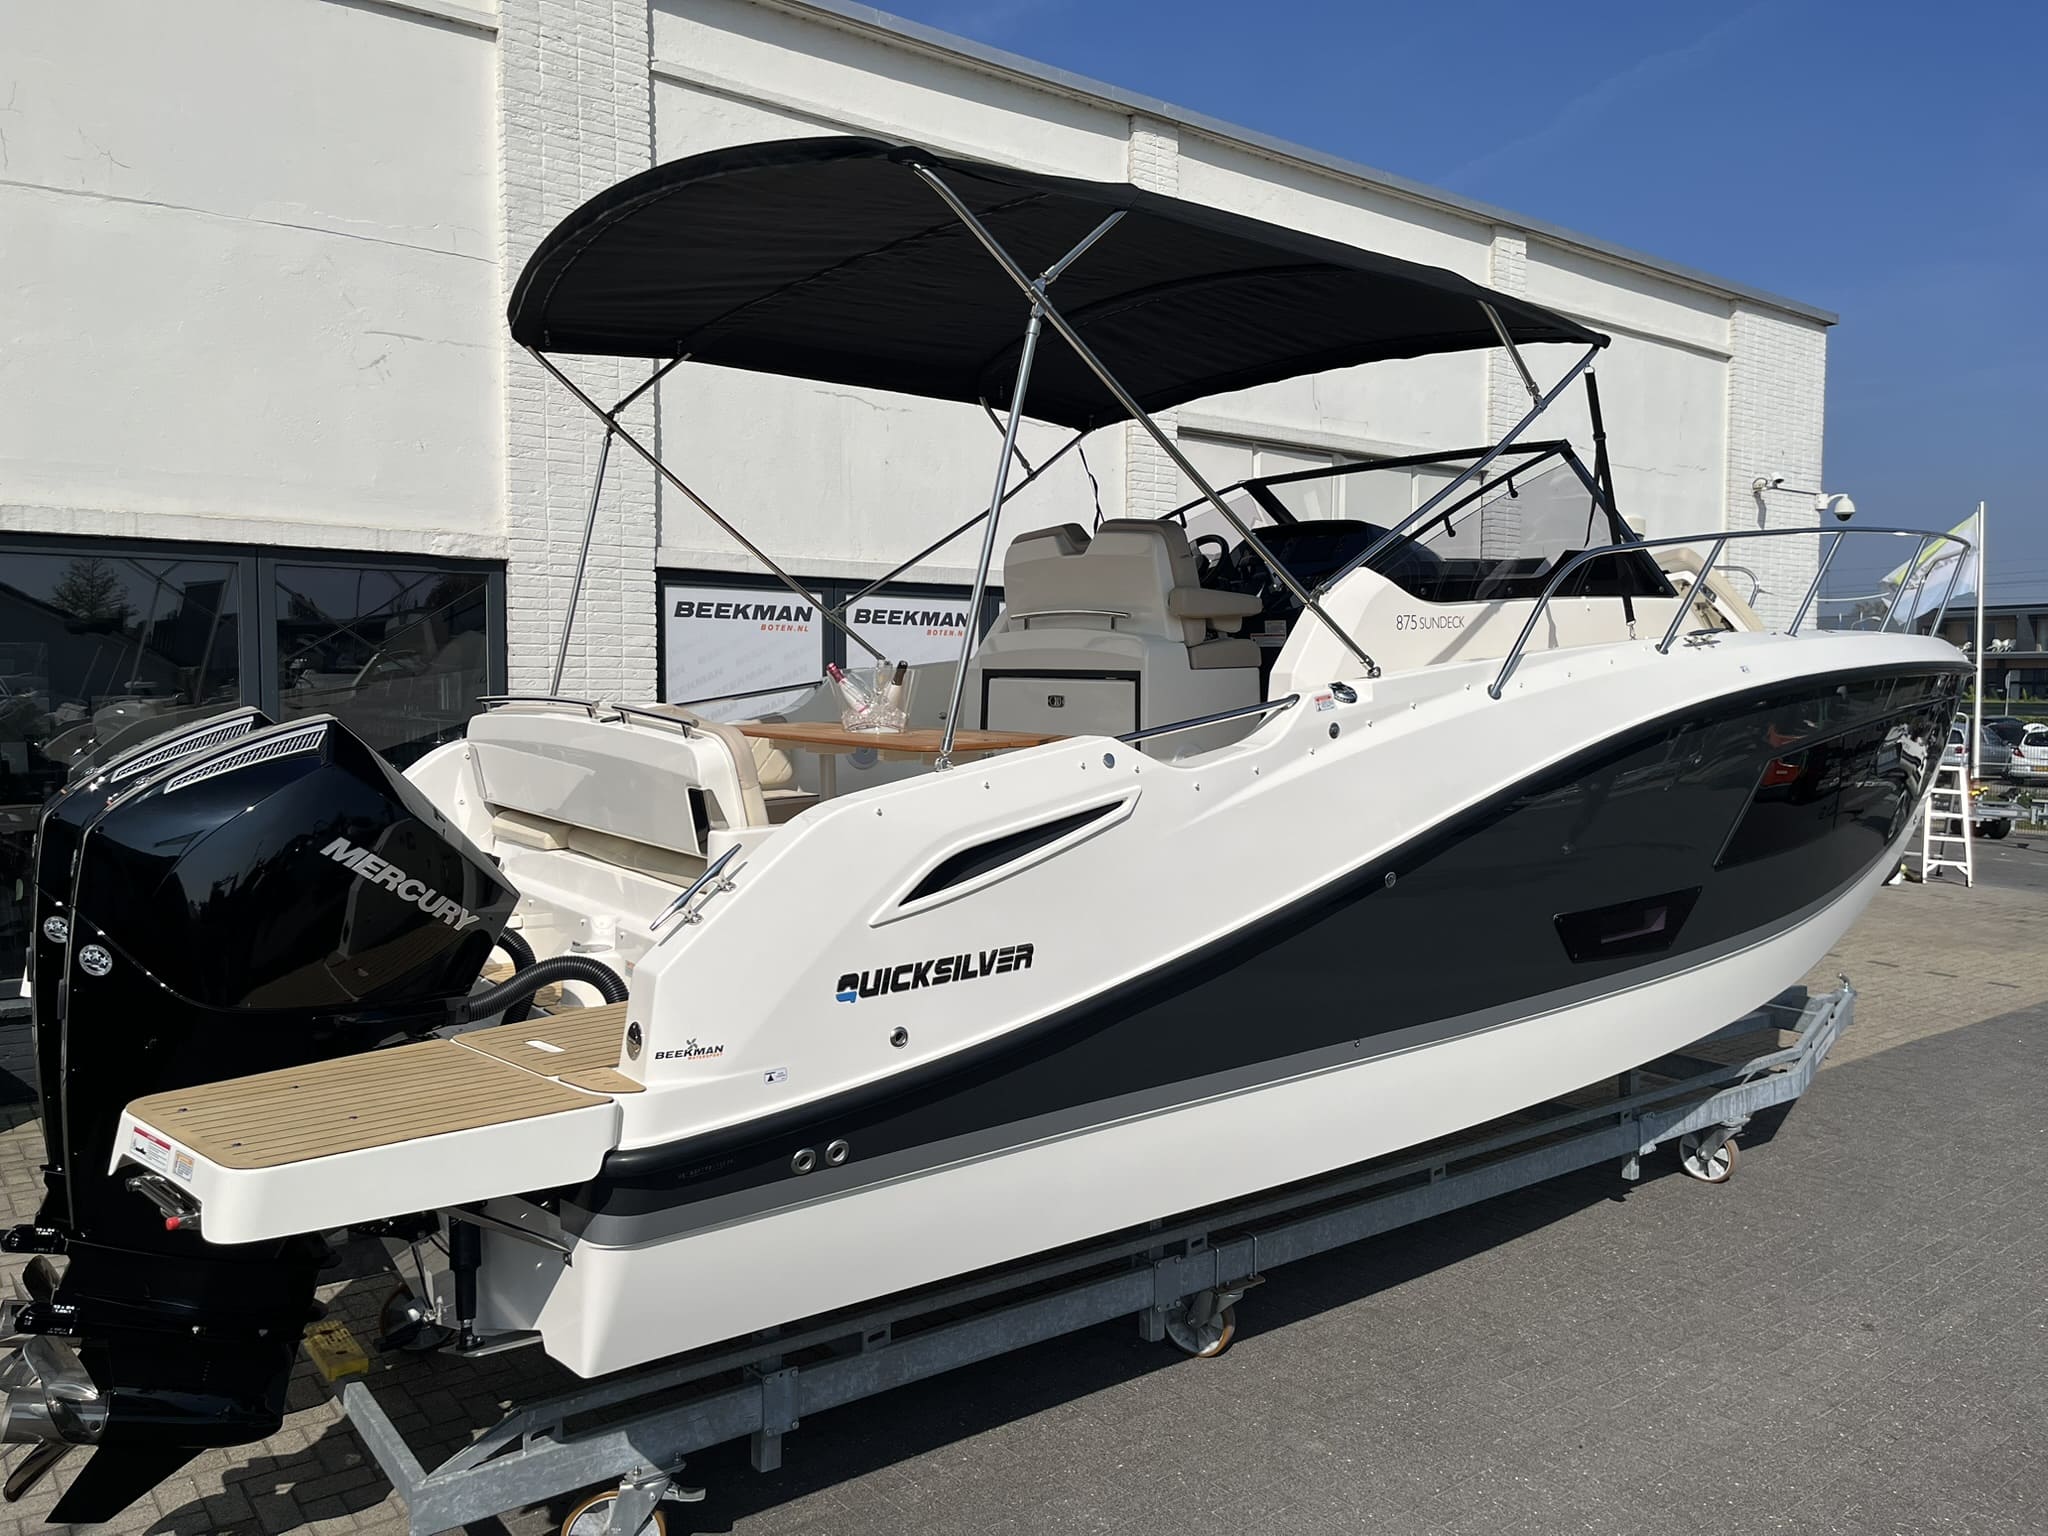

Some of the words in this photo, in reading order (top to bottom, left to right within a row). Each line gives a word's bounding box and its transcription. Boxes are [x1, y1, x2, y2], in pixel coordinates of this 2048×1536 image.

[674, 600, 814, 622] BEEKMAN
[854, 608, 969, 628] BEEKMAN
[760, 623, 810, 633] BOTEN.NL
[1396, 614, 1418, 631] 875
[1419, 615, 1465, 630] SUNDECK
[926, 629, 964, 637] BOTEN.N
[319, 836, 481, 932] MERCURY
[836, 943, 1035, 1003] QUICKSILVER
[655, 1045, 724, 1060] BEEKMAN
